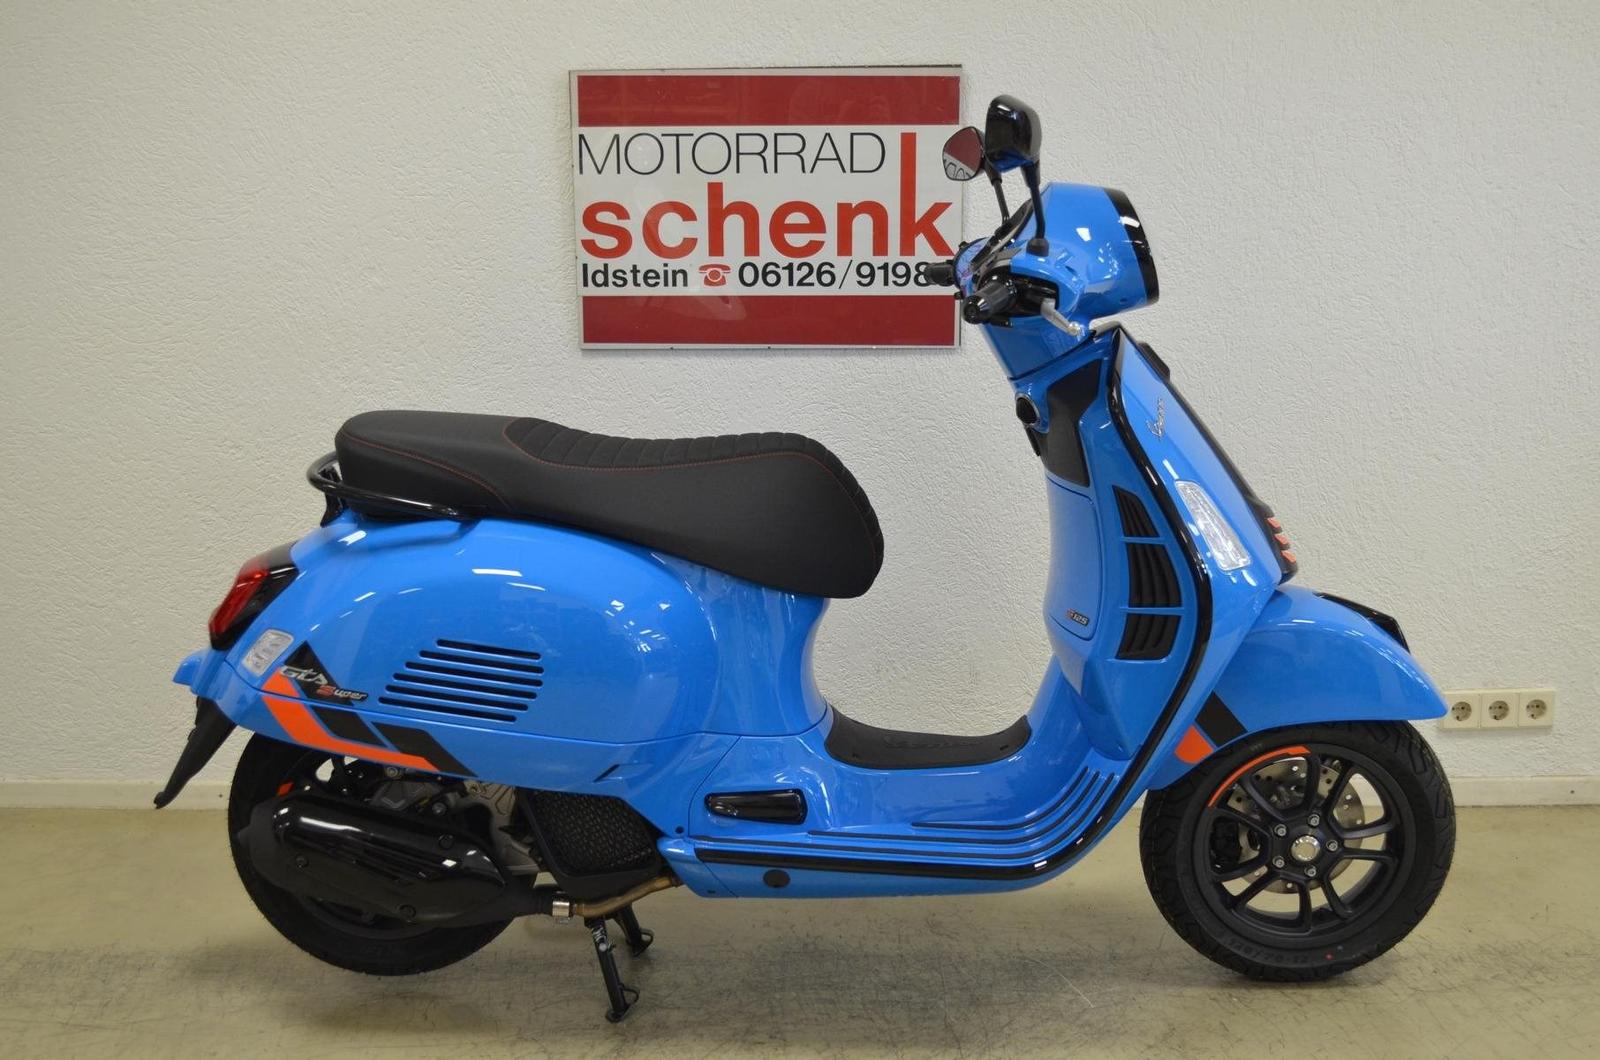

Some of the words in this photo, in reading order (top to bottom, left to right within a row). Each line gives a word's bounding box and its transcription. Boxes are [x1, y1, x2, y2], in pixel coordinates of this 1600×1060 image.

[578, 132, 886, 176] MOTORRAD
[580, 132, 955, 259] schenk
[582, 262, 688, 288] Idstein
[737, 259, 953, 290] 06126/9198
